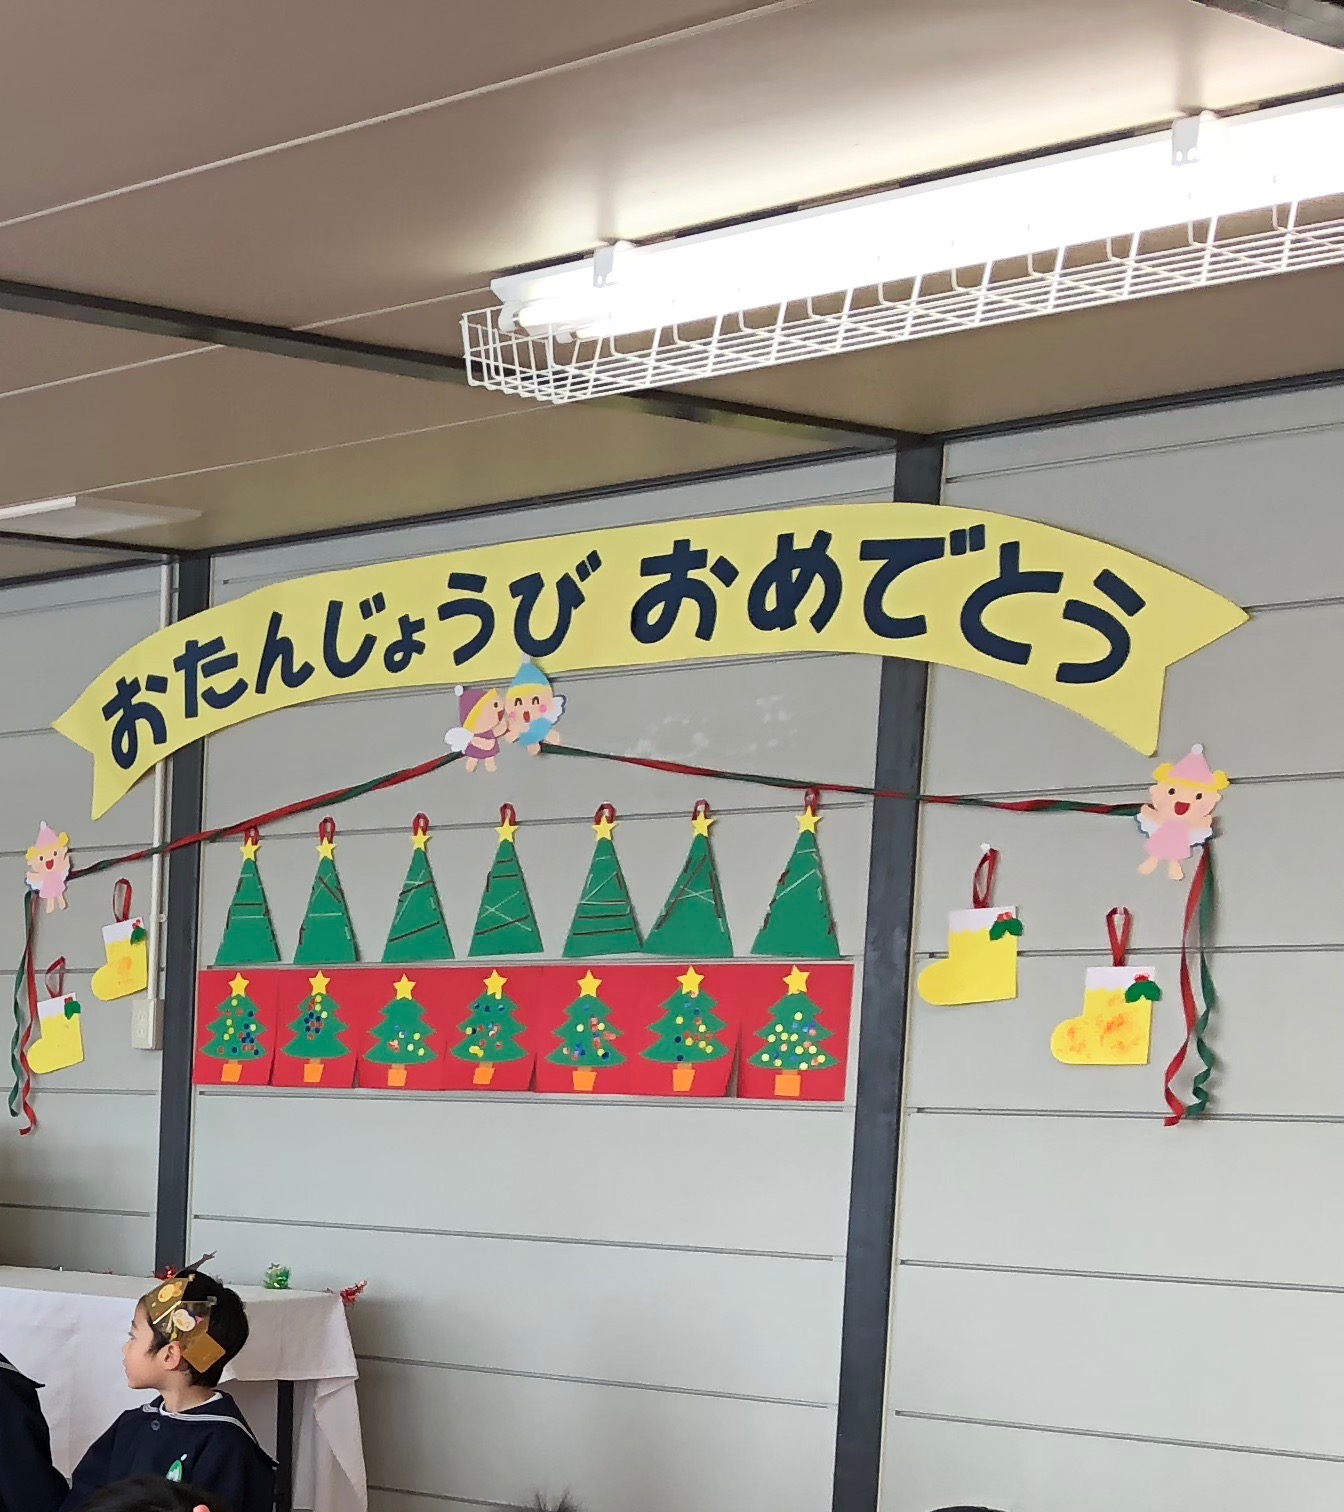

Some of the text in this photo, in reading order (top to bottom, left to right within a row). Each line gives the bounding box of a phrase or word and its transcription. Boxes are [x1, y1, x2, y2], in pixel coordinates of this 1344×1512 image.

[102, 524, 1146, 770] おたんじょうび おめでとう
